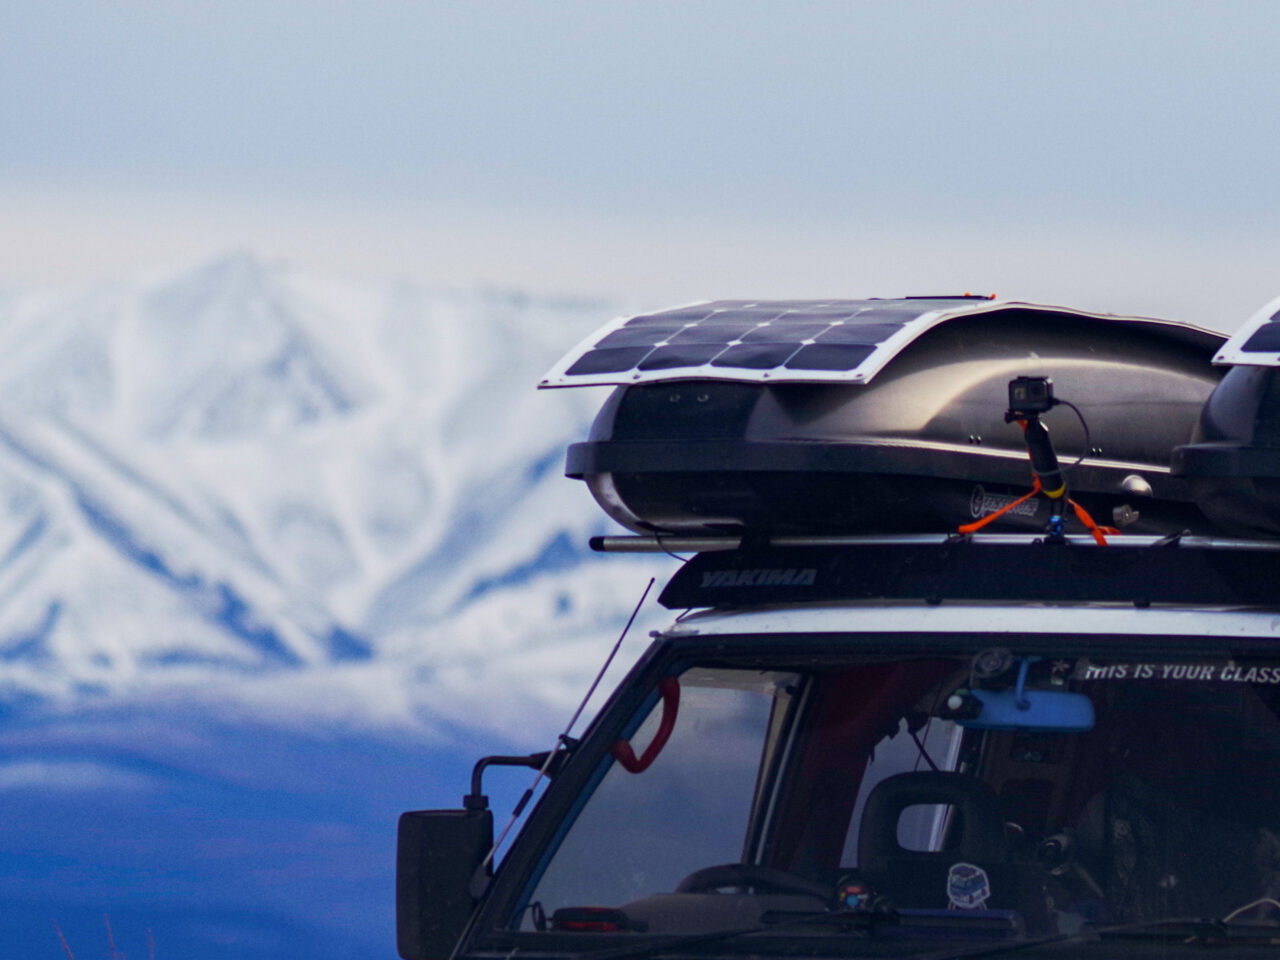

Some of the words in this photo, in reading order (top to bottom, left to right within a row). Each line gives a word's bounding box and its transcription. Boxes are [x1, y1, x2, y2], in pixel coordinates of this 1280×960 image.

[698, 568, 817, 588] YAKIMA
[1085, 664, 1129, 680] THIS
[1134, 664, 1155, 679] IS
[1162, 664, 1215, 680] YOUR
